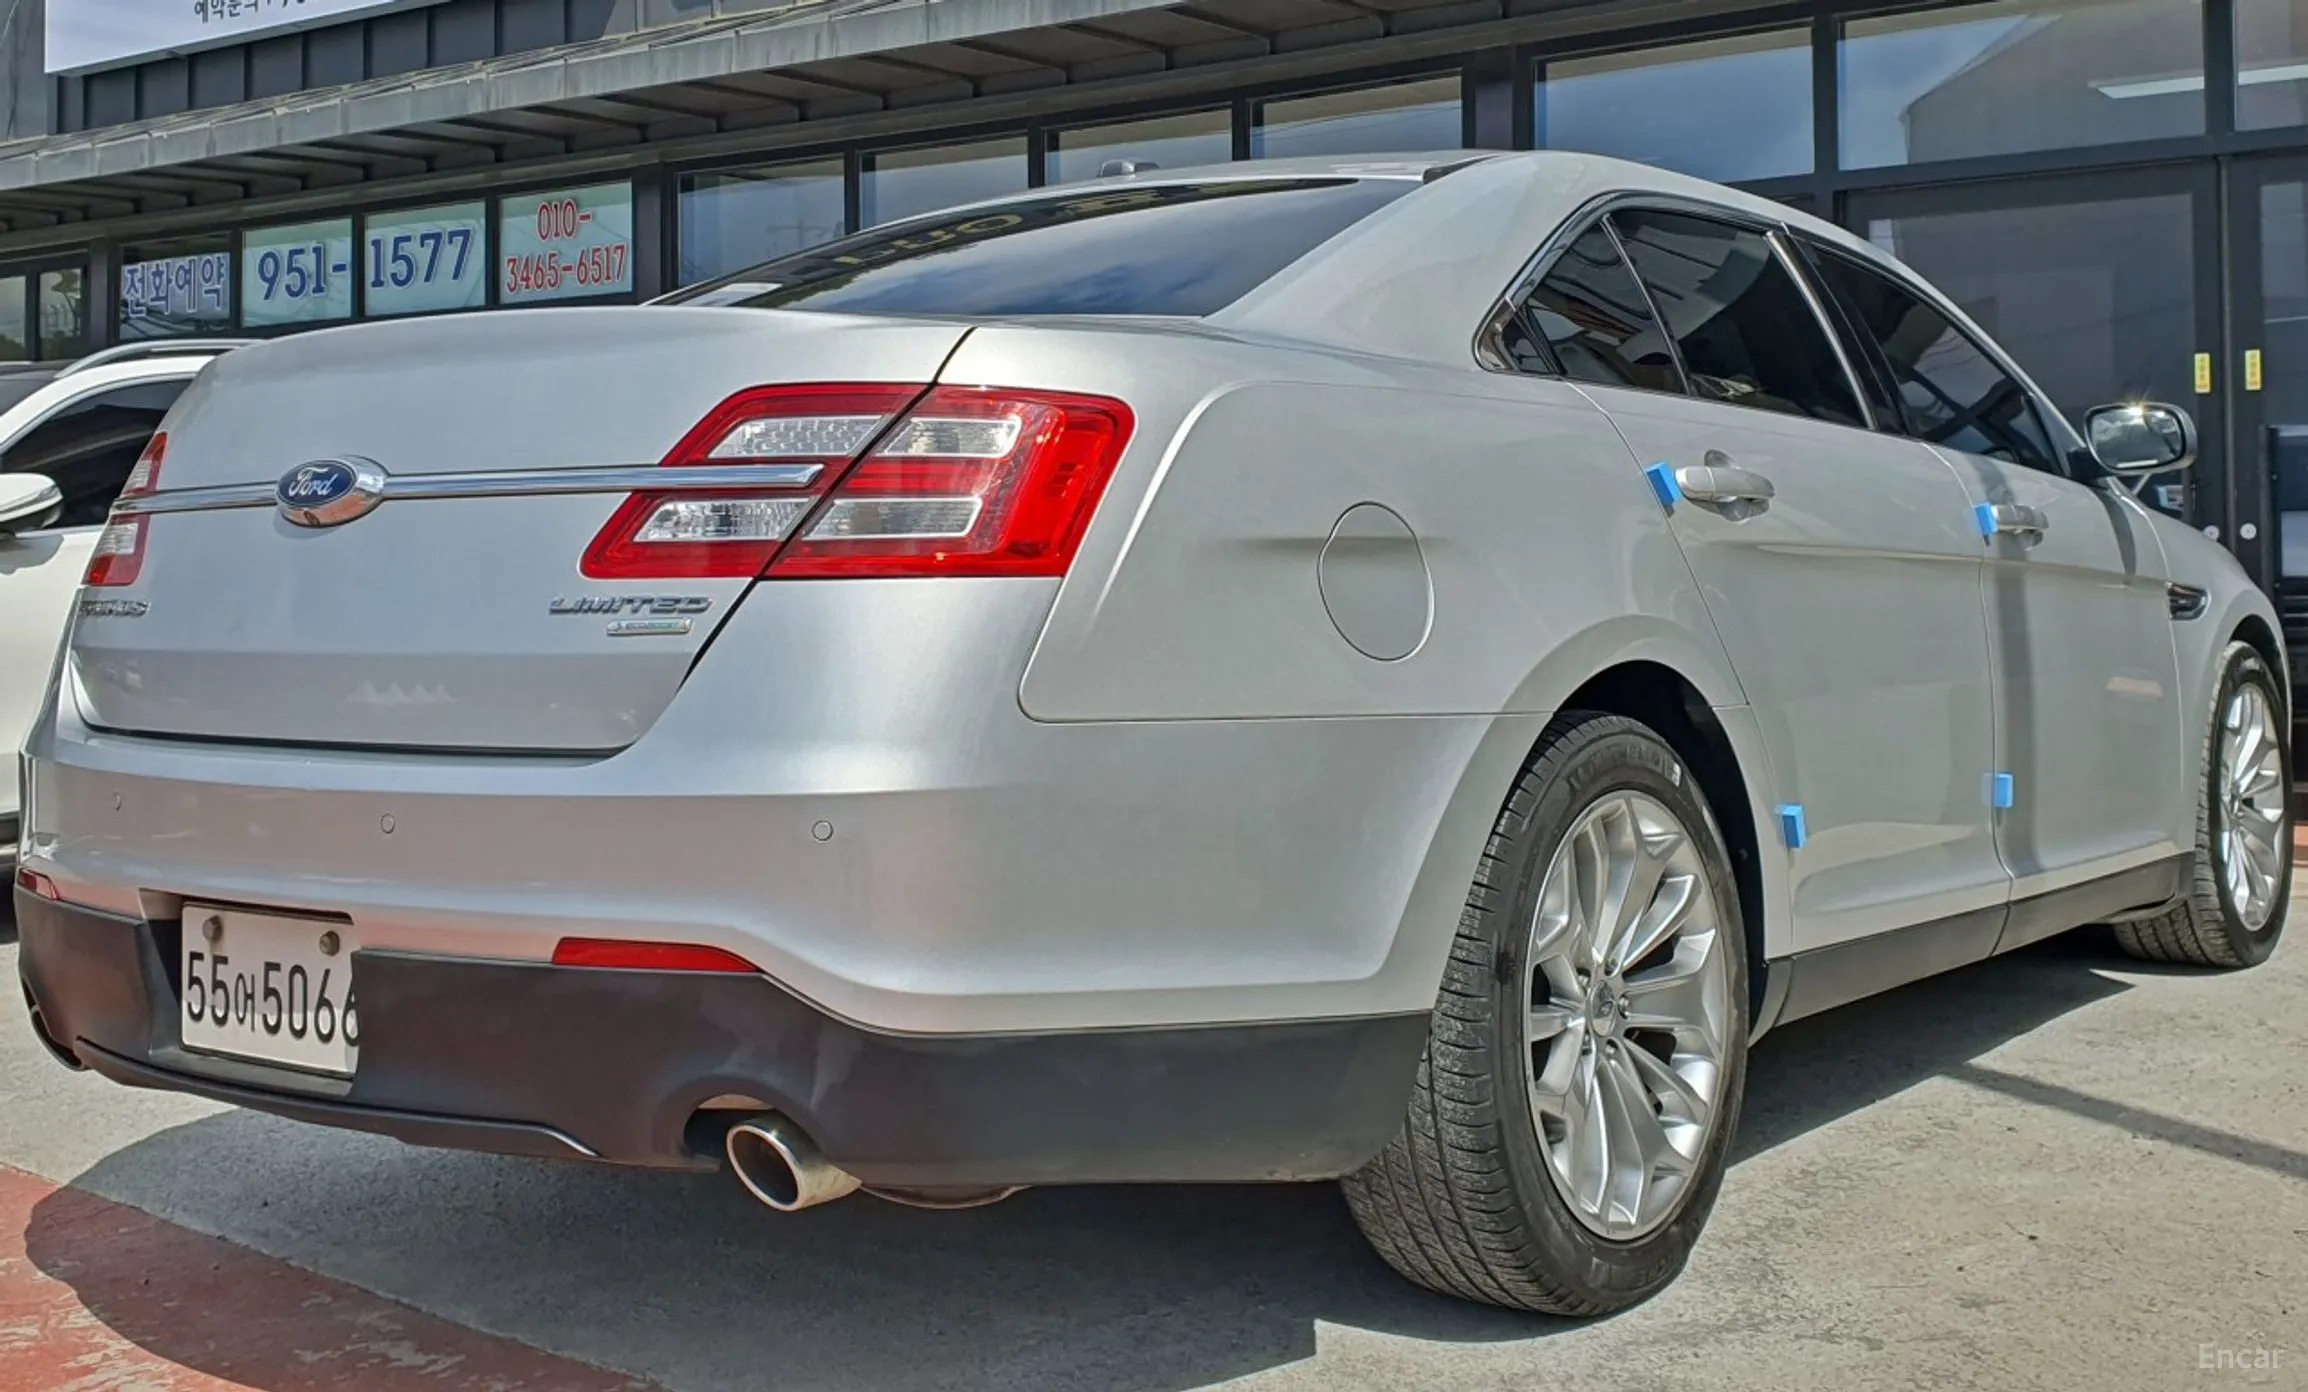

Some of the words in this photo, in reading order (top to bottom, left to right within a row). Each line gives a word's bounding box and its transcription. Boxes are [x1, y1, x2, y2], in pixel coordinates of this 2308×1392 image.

[538, 200, 592, 241] 010-
[124, 255, 229, 317] 전화예약
[258, 245, 347, 301] 951-
[370, 228, 472, 288] 1577
[506, 244, 626, 293] 3465-6517
[288, 467, 339, 497] Ford
[549, 596, 713, 615] LIMITED
